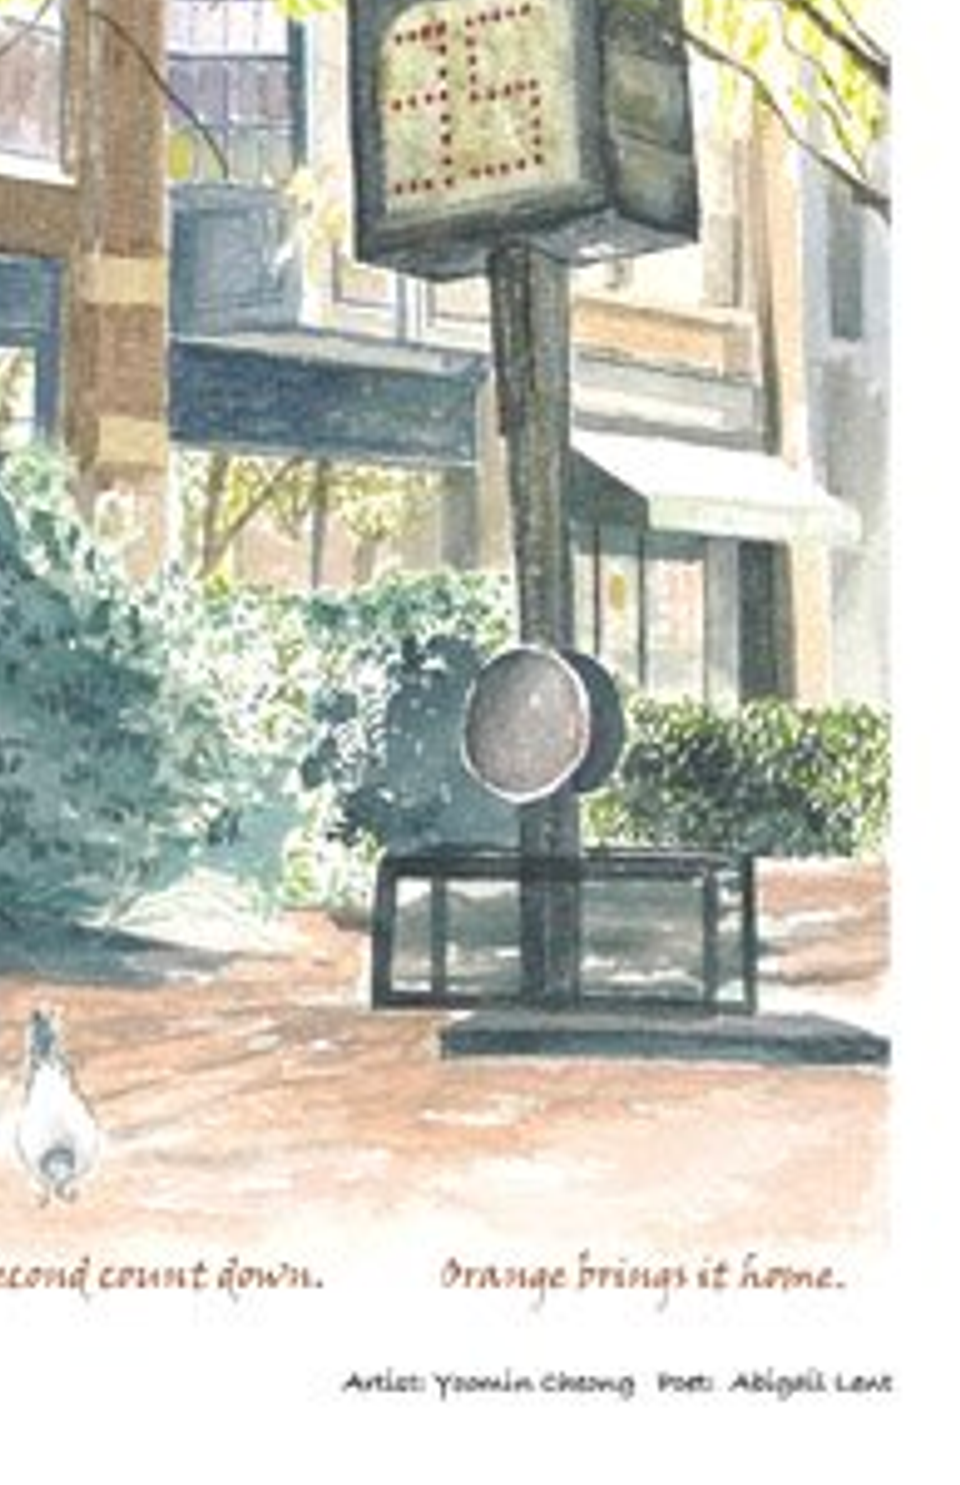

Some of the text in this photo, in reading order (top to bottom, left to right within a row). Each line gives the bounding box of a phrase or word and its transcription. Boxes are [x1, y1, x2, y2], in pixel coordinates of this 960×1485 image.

[97, 1260, 208, 1291] count
[216, 1256, 325, 1302] down.
[442, 1248, 847, 1314] Orange brings it home.
[342, 1367, 895, 1402] Artist: Yoomin Cheong Poet: Abigail Lent
